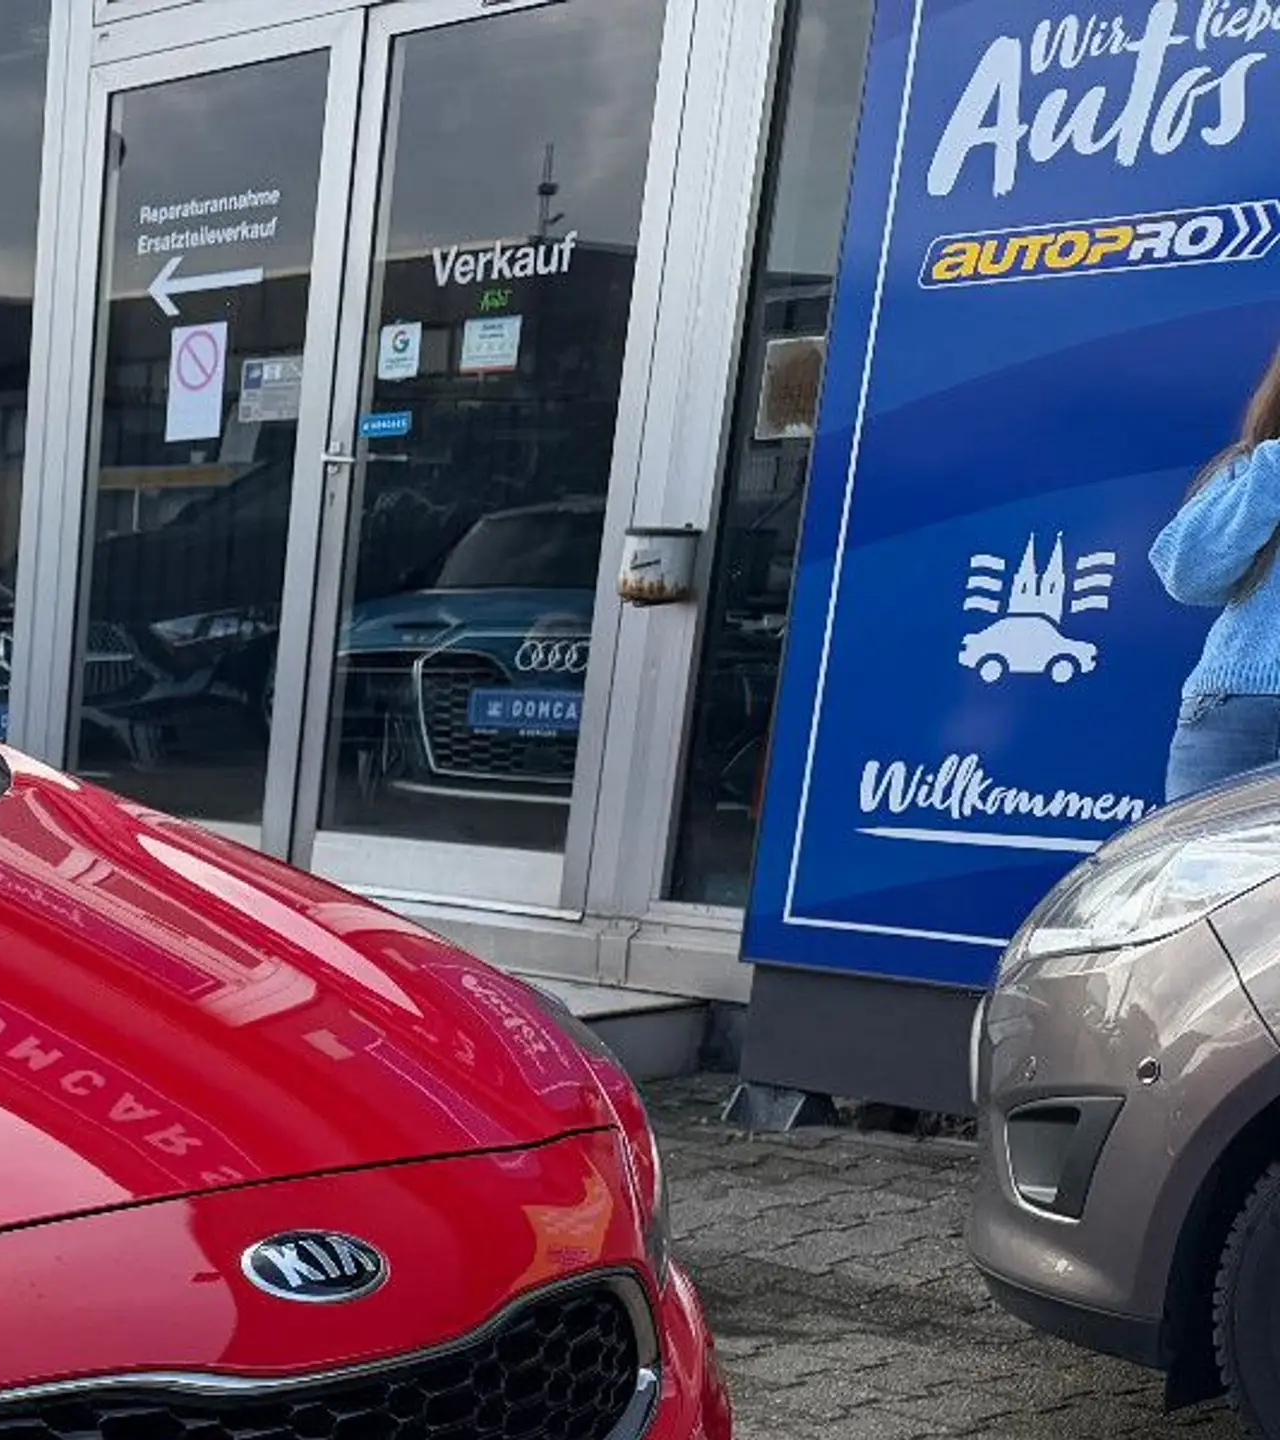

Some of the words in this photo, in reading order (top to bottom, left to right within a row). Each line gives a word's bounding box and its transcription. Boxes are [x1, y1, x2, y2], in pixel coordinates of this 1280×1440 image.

[1030, 14, 1130, 75] Wir
[926, 0, 1268, 198] Autos
[140, 189, 281, 224] Reparaturannahme
[137, 216, 278, 255] Ersatzteileverkauf
[431, 230, 579, 287] Verkauf
[511, 699, 579, 720] DOMCA
[859, 753, 1156, 823] Willkommen
[258, 1235, 377, 1288] KIA
